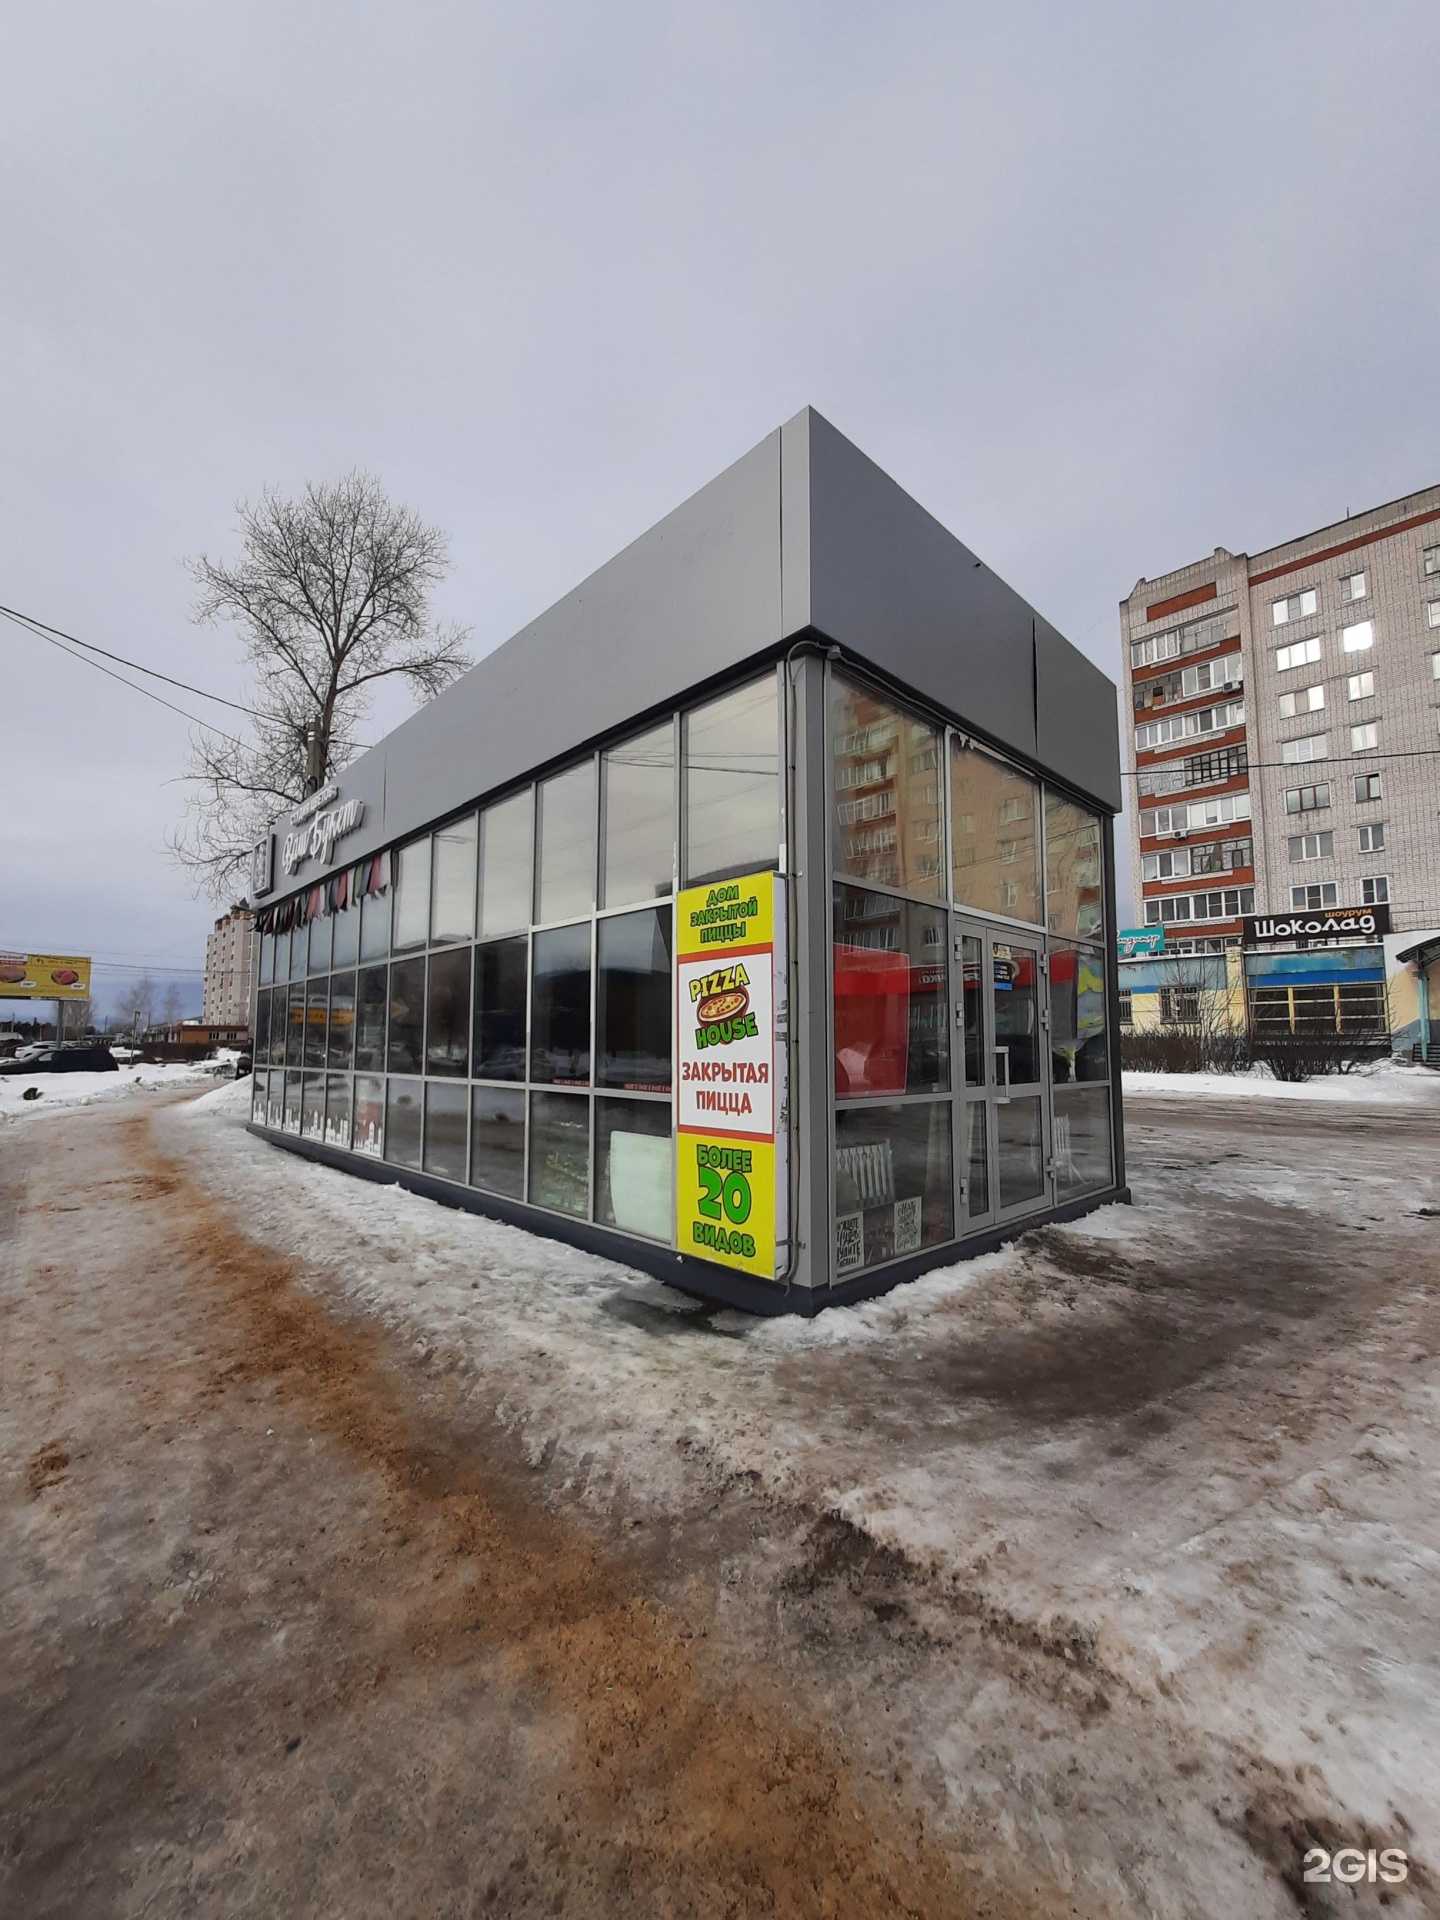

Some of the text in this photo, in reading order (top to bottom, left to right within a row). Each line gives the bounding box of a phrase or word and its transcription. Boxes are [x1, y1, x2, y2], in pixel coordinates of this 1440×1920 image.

[706, 884, 740, 907] ДОМ
[690, 897, 758, 928] ЗАКРЫТОЙ
[1254, 914, 1376, 938] Шоколад
[1325, 907, 1372, 918] шоурум
[700, 921, 747, 944] ПИЦЦЫ
[689, 963, 751, 1003] PIZZA
[695, 1011, 759, 1050] HOUSE
[682, 1062, 769, 1084] ЗАКРЫТАЯ
[696, 1090, 752, 1116] ПИЦЦА
[697, 1144, 752, 1173] БОЛЕЕ
[697, 1165, 752, 1225] 20
[693, 1221, 756, 1258] ВИДОВ
